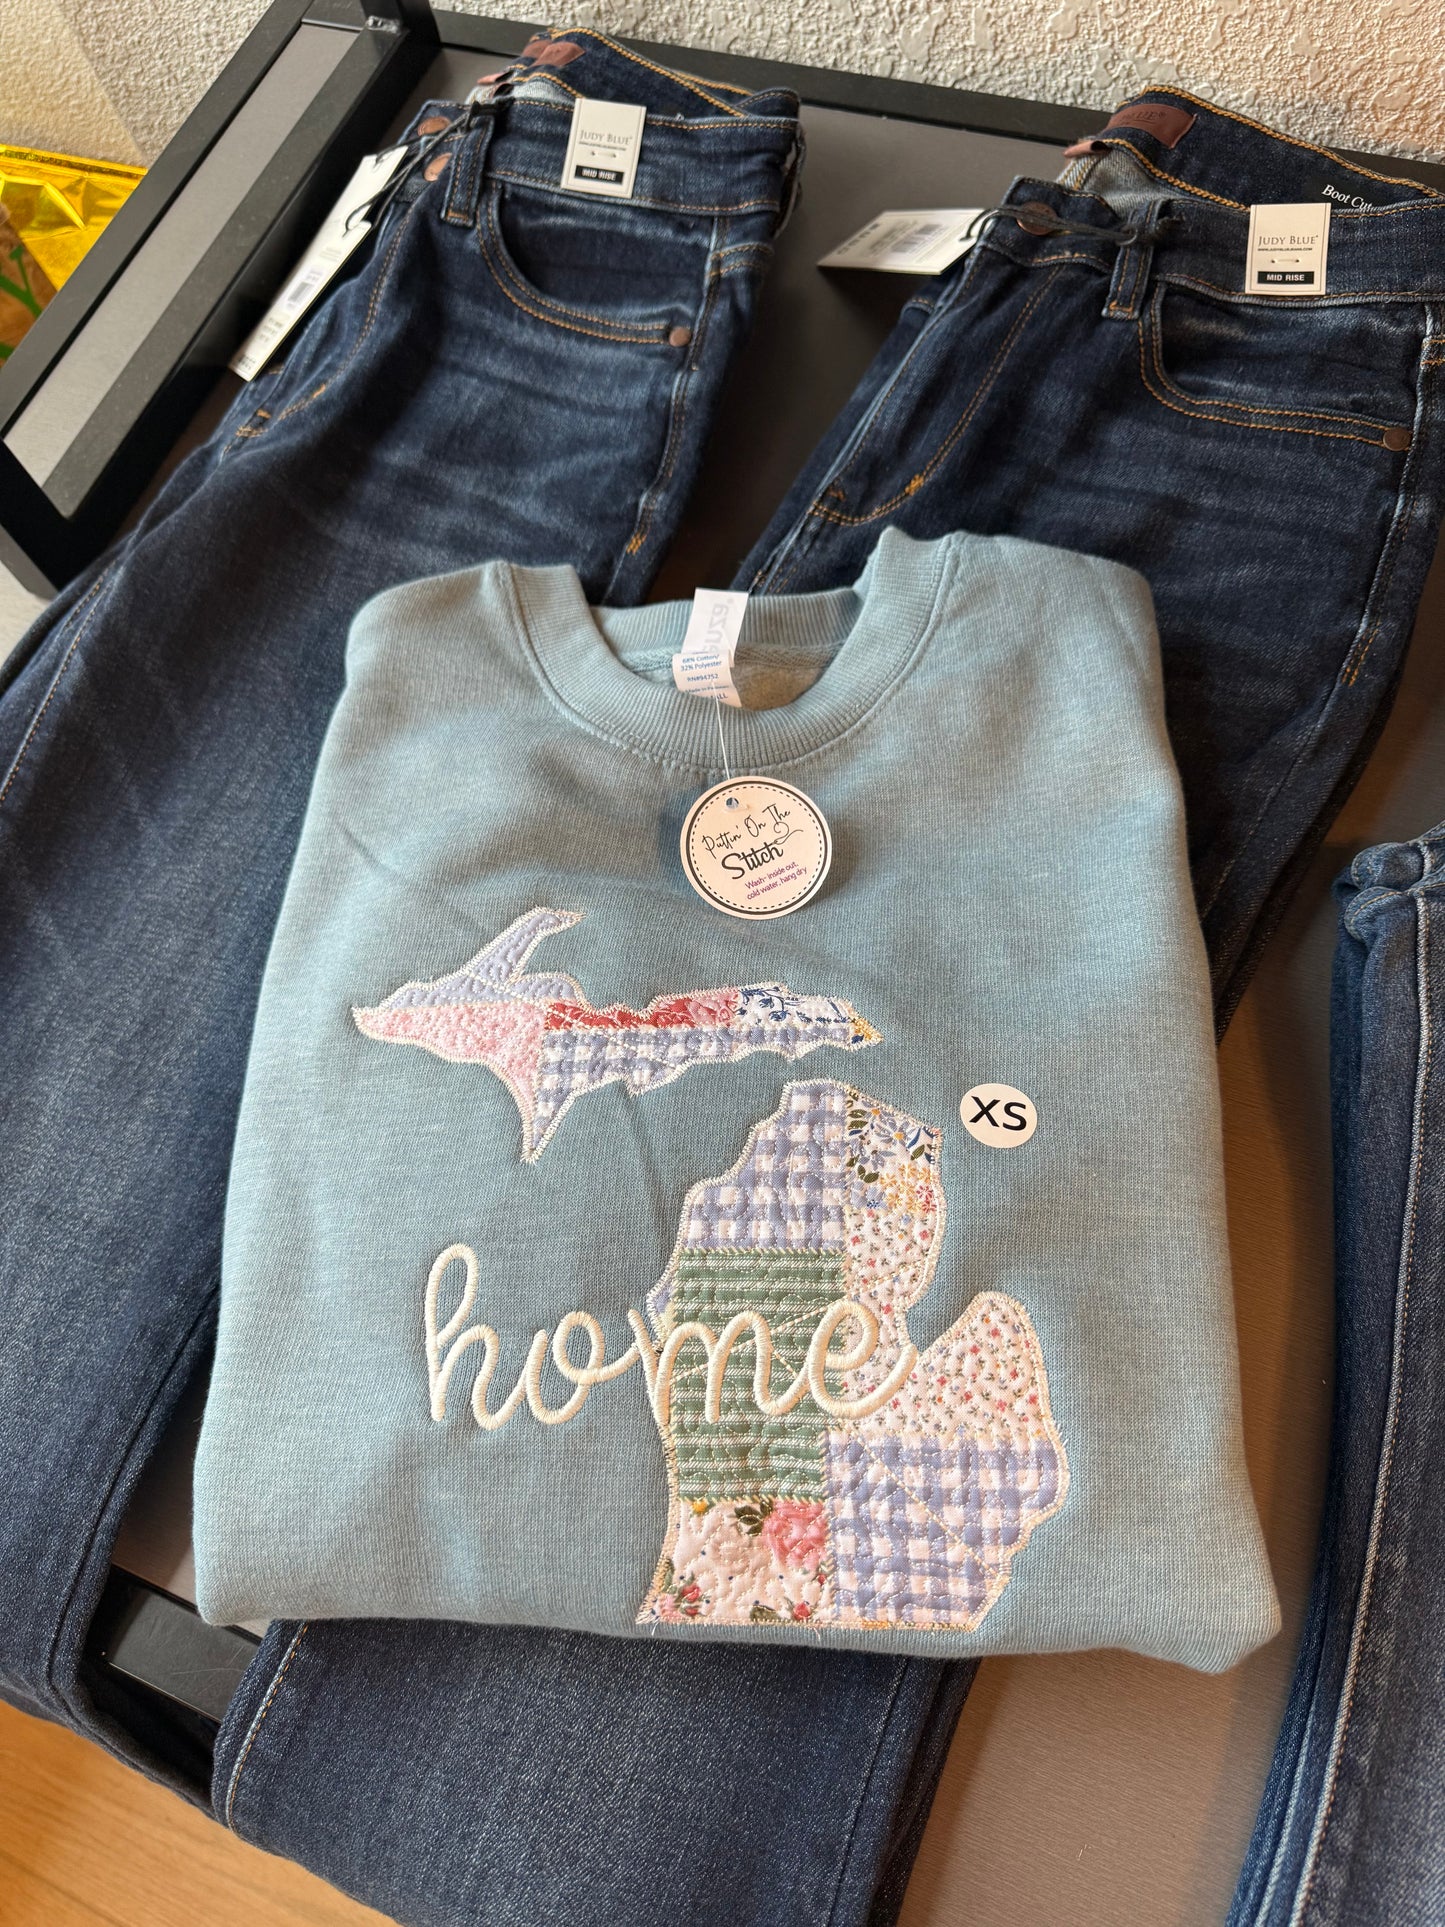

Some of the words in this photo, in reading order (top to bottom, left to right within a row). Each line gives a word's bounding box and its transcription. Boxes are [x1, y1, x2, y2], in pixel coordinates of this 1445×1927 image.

[580, 129, 605, 142] JUDY
[607, 132, 631, 145] BLUE
[582, 168, 597, 178] MID
[598, 169, 616, 180] RISE
[1321, 184, 1350, 204] Boot
[1258, 235, 1286, 247] JUDY
[1289, 235, 1316, 245] BLUE
[1266, 274, 1283, 282] MID
[1285, 274, 1305, 282] RISE
[694, 660, 722, 670] Polyester
[744, 814, 767, 838] On
[762, 803, 791, 826] The
[721, 842, 784, 879] Stitch
[767, 867, 785, 880] inside
[746, 889, 761, 900] cold
[760, 879, 781, 893] water,
[780, 871, 797, 885] hang
[795, 866, 808, 878] dry
[968, 1095, 1027, 1131] XS
[424, 1242, 919, 1431] home
